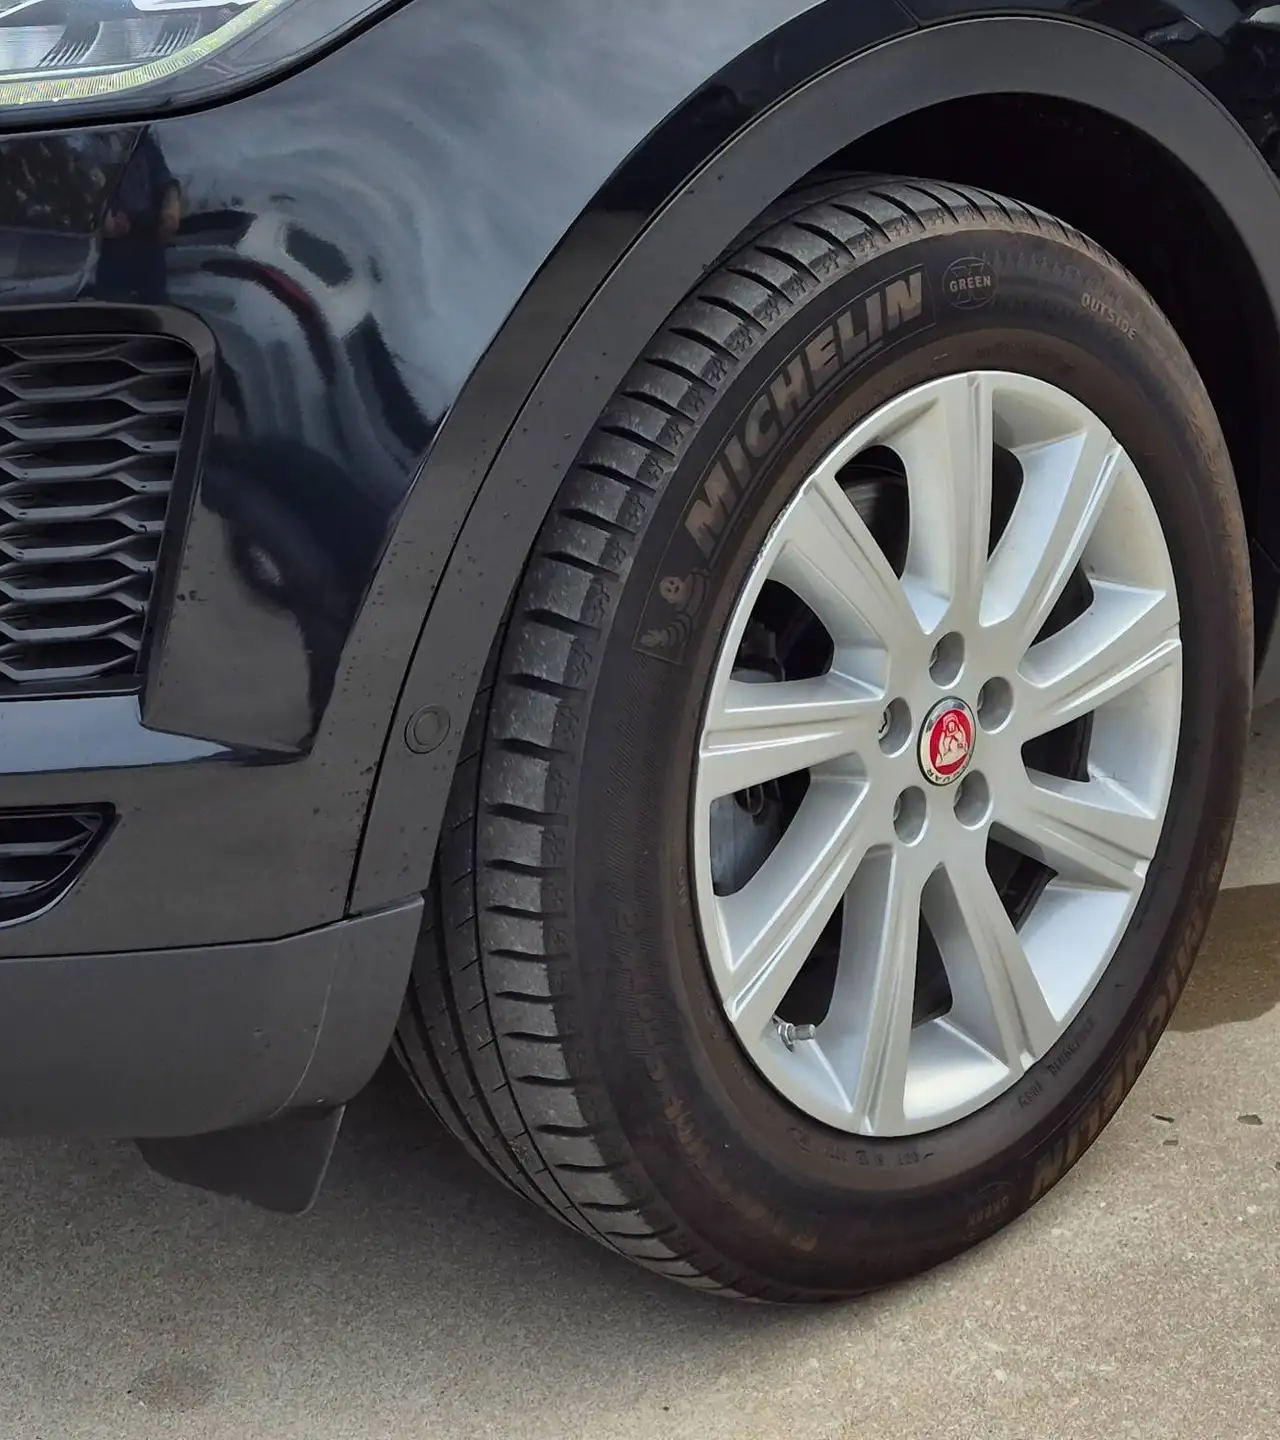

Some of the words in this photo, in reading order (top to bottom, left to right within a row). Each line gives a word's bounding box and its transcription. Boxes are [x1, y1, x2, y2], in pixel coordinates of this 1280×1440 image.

[949, 274, 992, 293] GREEN
[1080, 291, 1138, 341] OUTSIDE
[684, 271, 923, 558] MICHELIN
